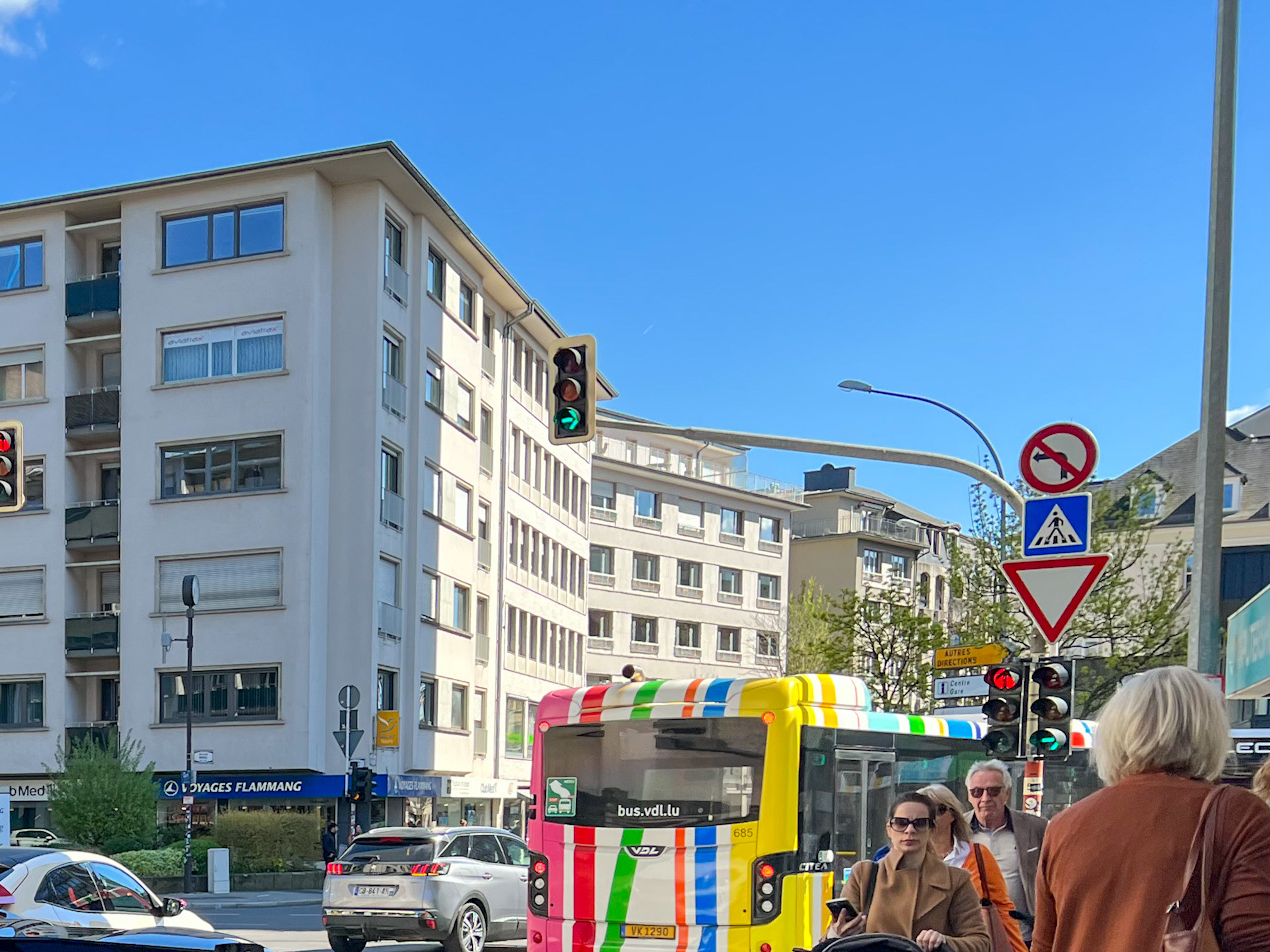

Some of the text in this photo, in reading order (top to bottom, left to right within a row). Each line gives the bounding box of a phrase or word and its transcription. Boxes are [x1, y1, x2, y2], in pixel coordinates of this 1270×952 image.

[944, 648, 971, 657] AUTRES
[937, 656, 978, 667] DIRECTIONS
[18, 785, 45, 797] Med
[235, 781, 303, 792] FLAMMANG
[617, 804, 680, 817] bus.vdl.lu
[733, 828, 754, 838] 685
[631, 846, 660, 855] VDL
[631, 926, 669, 937] VK 1290
